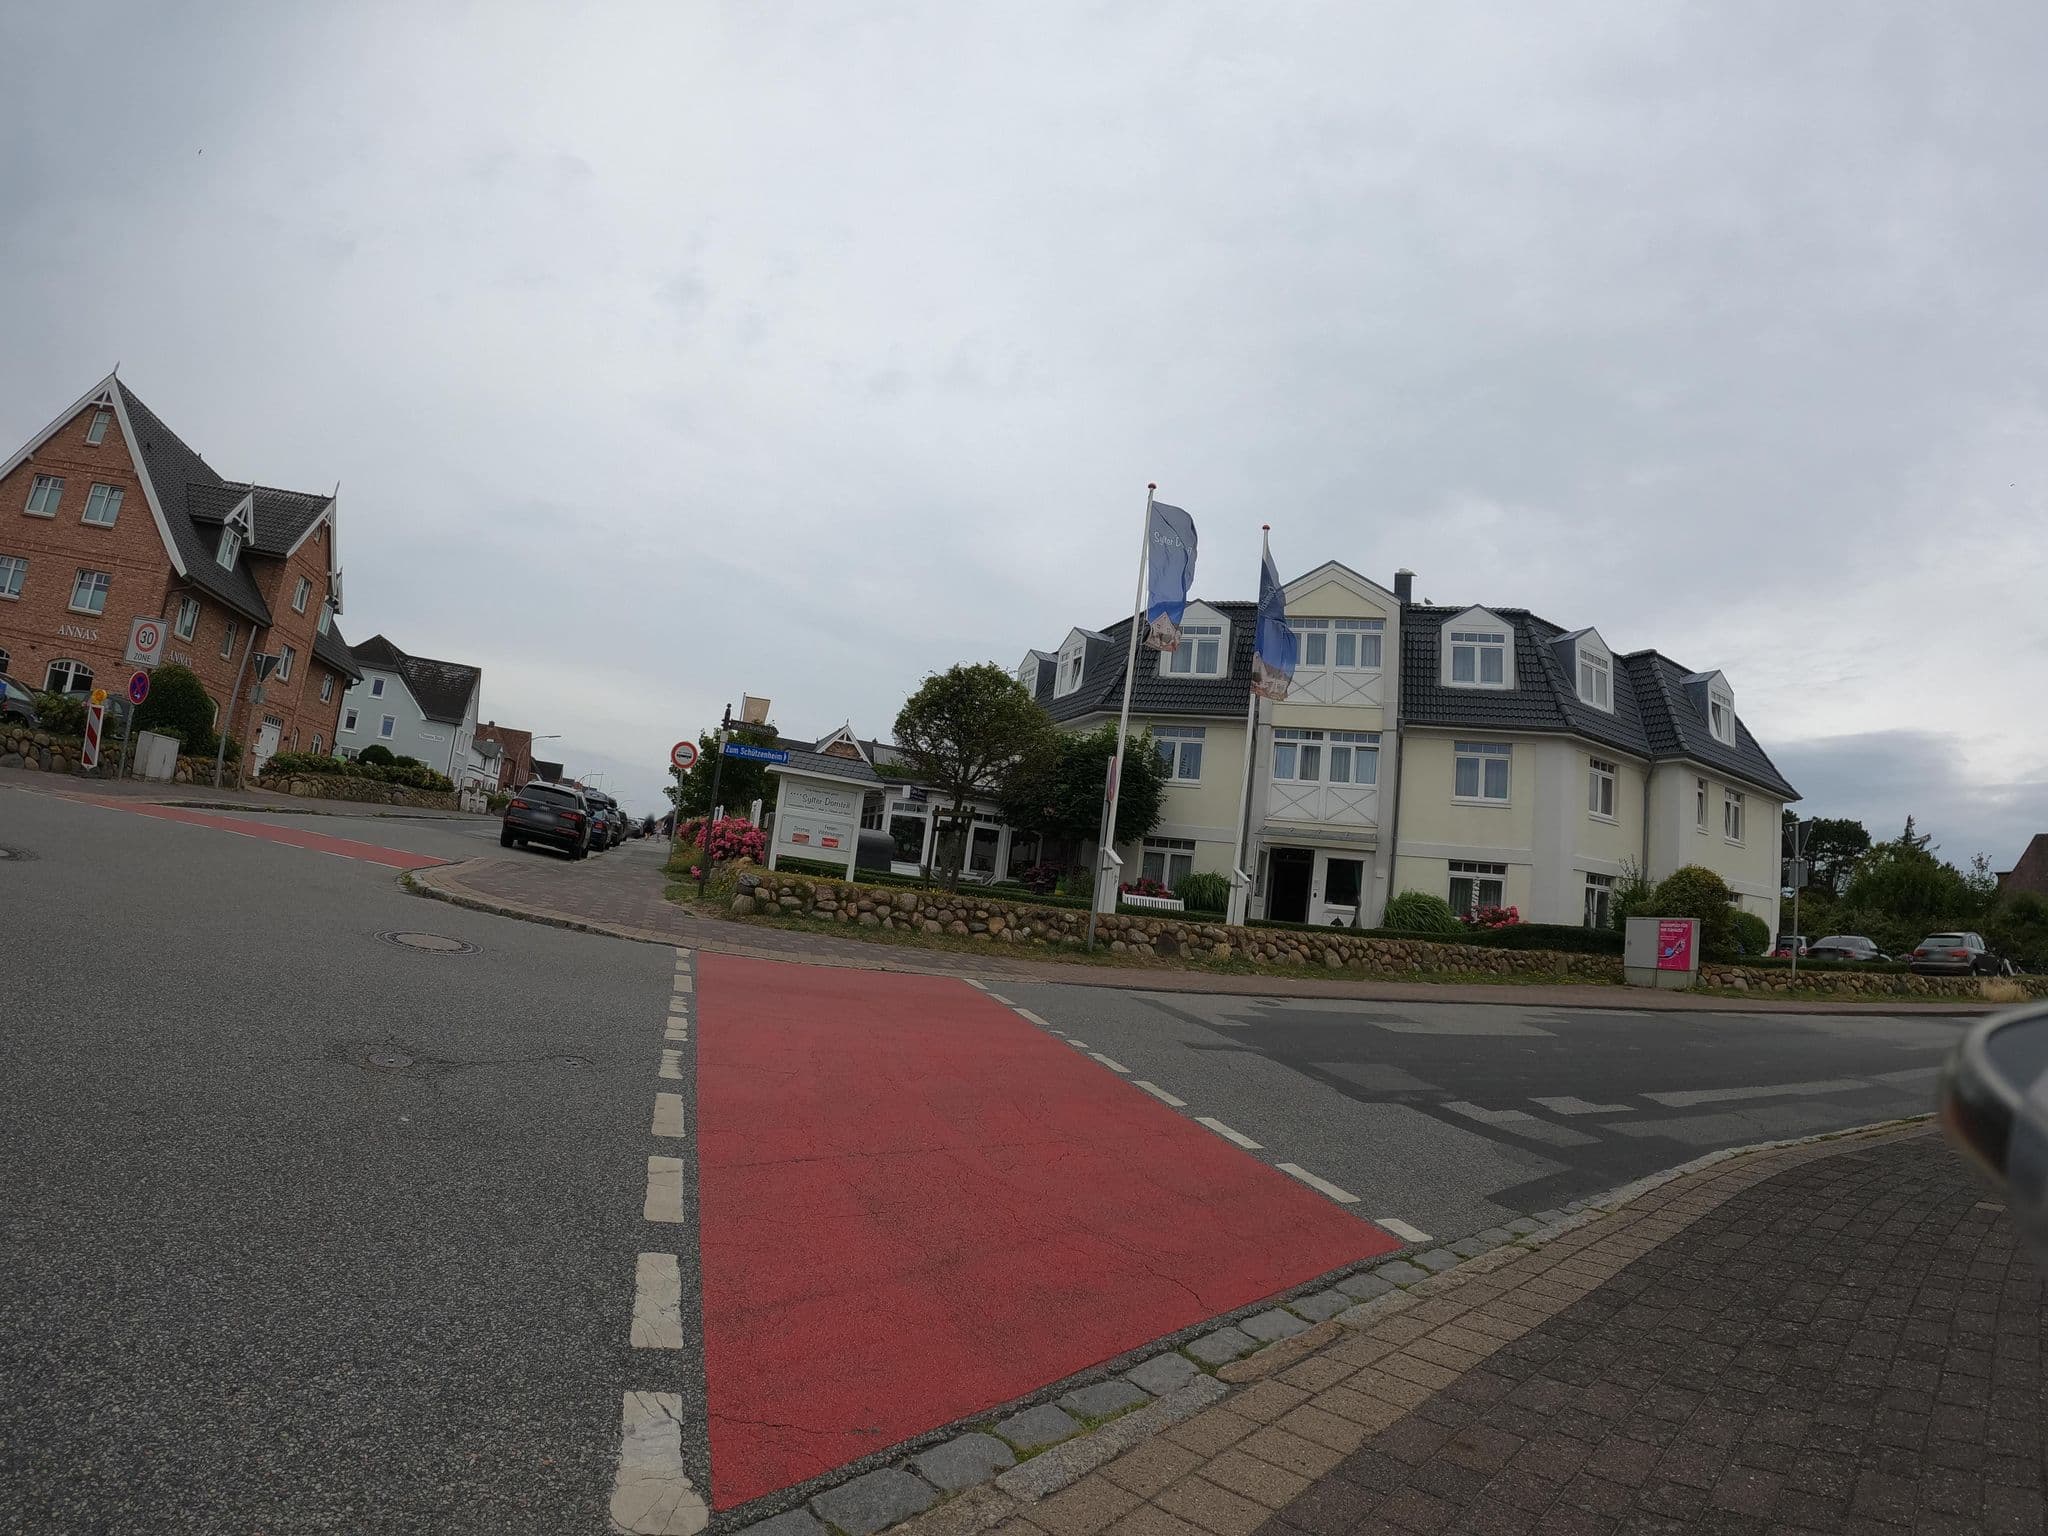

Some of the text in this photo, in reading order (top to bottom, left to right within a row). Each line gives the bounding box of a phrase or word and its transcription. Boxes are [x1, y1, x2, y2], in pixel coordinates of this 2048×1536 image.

[139, 630, 154, 645] 30
[133, 652, 151, 662] ZONE
[725, 744, 783, 760] Zum Schützenheim
[802, 793, 822, 804] Sylter
